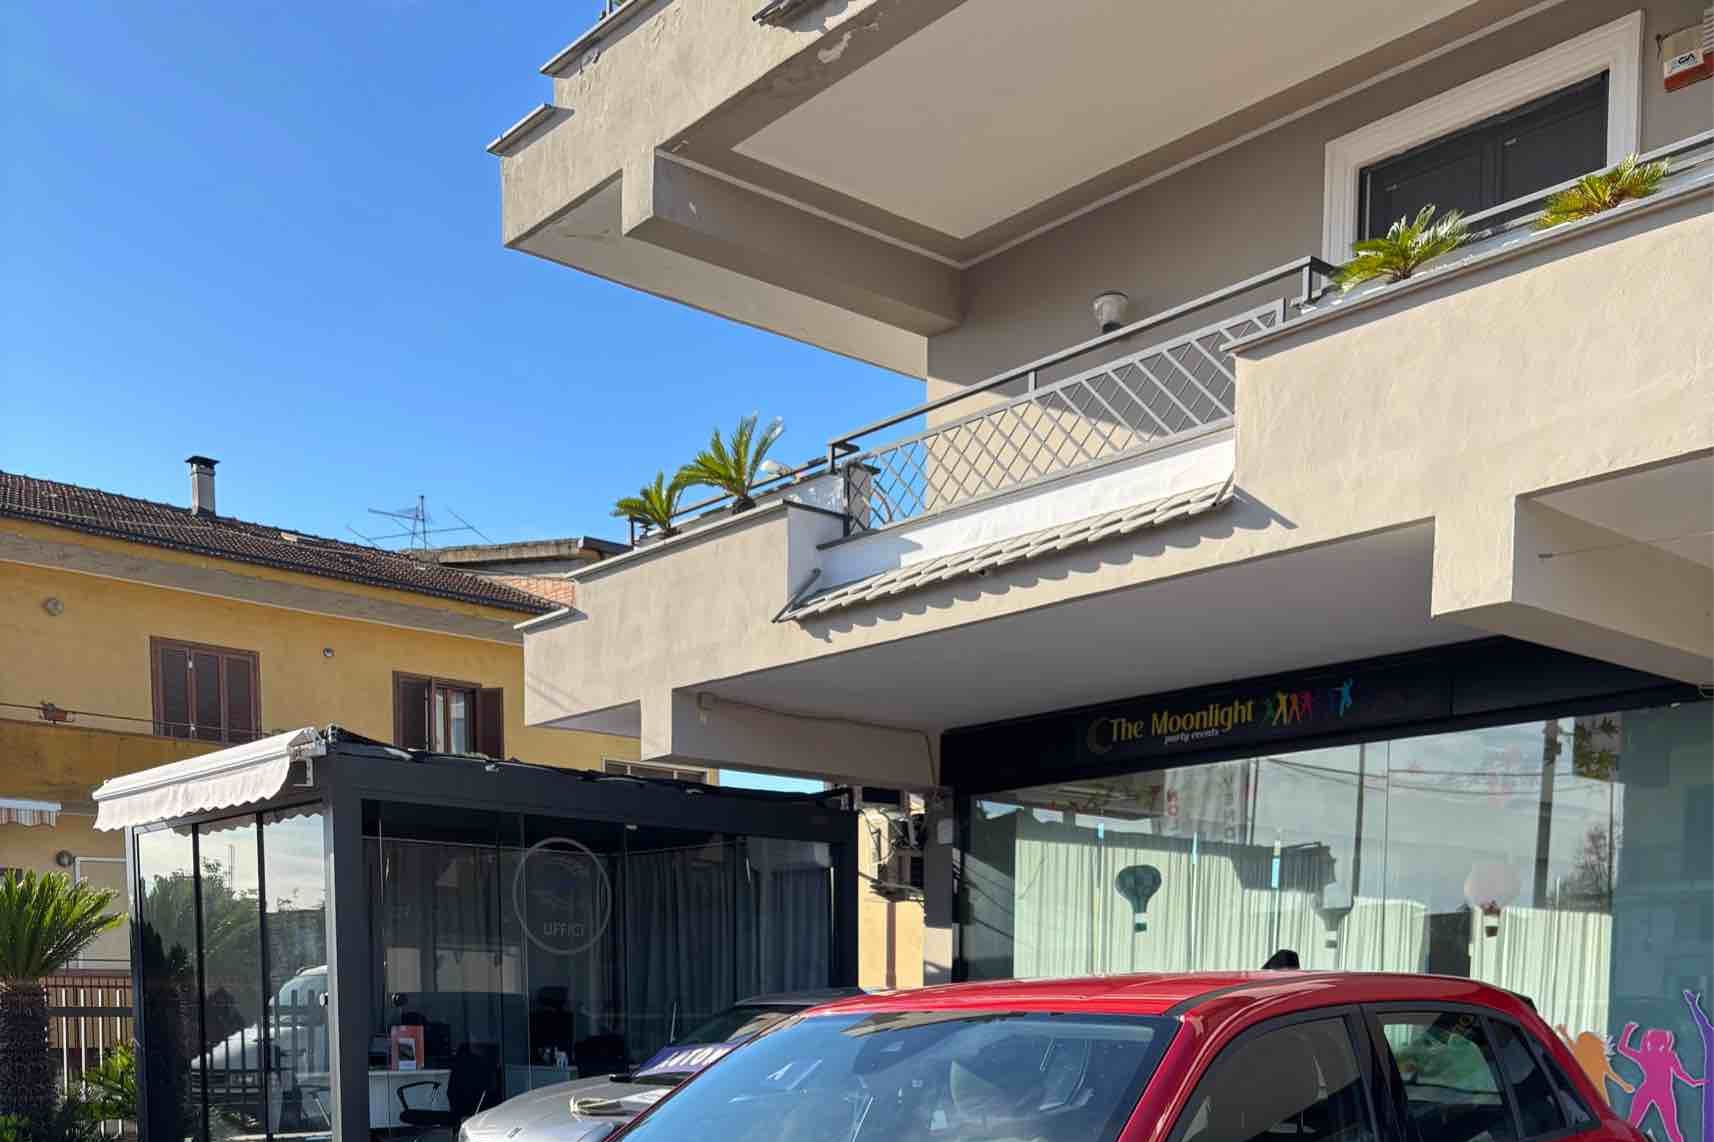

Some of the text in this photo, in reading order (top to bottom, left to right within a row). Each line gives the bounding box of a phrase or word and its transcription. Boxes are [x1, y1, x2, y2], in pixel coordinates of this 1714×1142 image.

[1110, 700, 1253, 742] The Moonlight
[1163, 728, 1219, 745] party events
[543, 921, 585, 937] UFFICI
